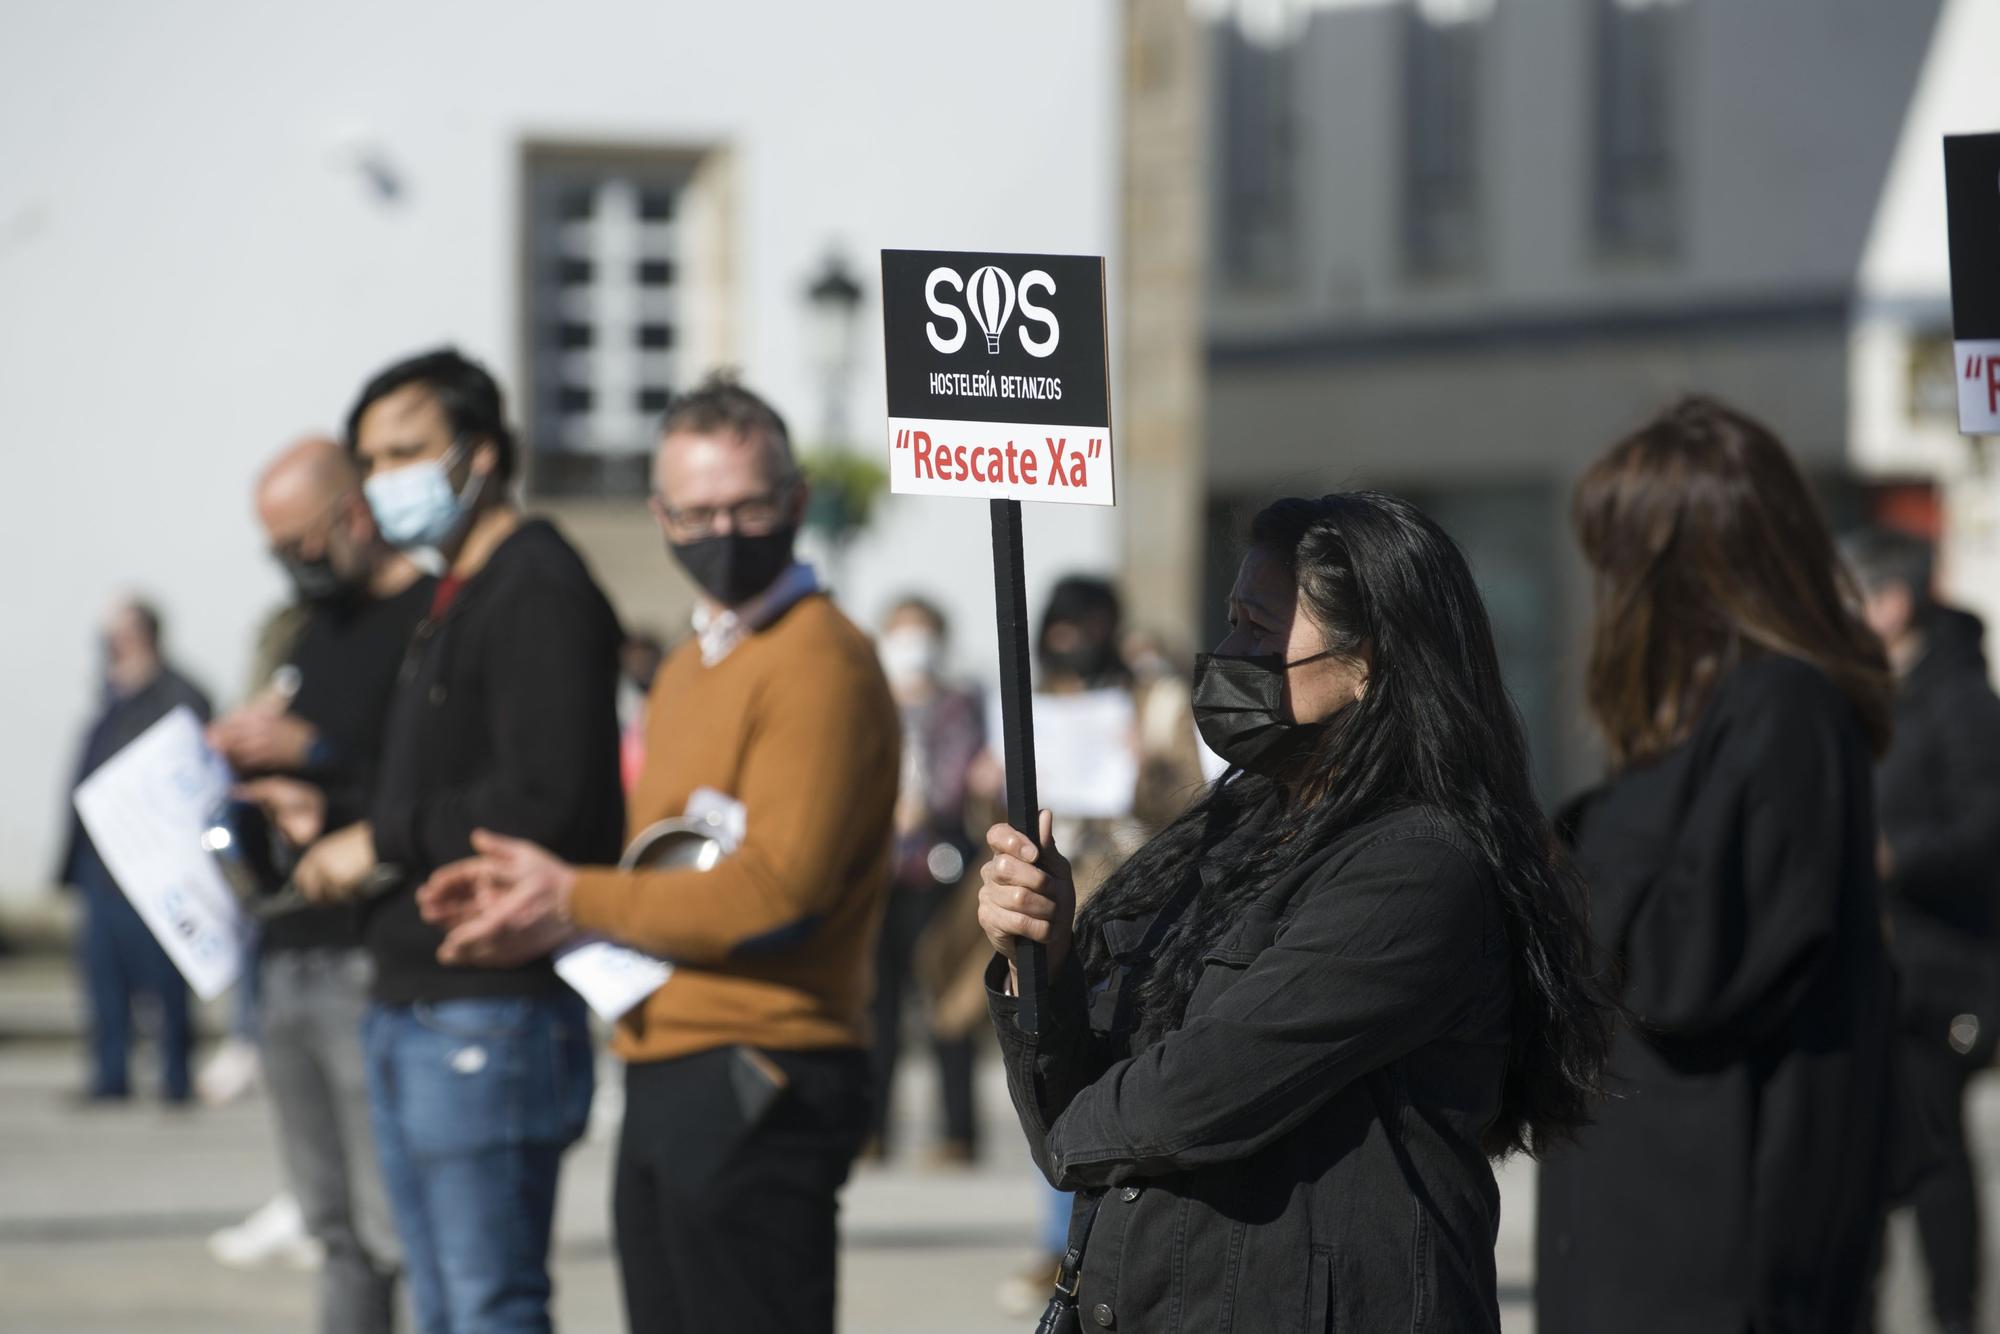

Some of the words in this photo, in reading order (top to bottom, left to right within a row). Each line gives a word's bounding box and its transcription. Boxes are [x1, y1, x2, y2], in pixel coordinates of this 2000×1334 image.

[929, 369, 998, 398] HOSTELERÍA
[1000, 375, 1062, 400] BETANZOS
[896, 429, 1037, 486] “Rescate
[1045, 437, 1102, 488] Xa”
